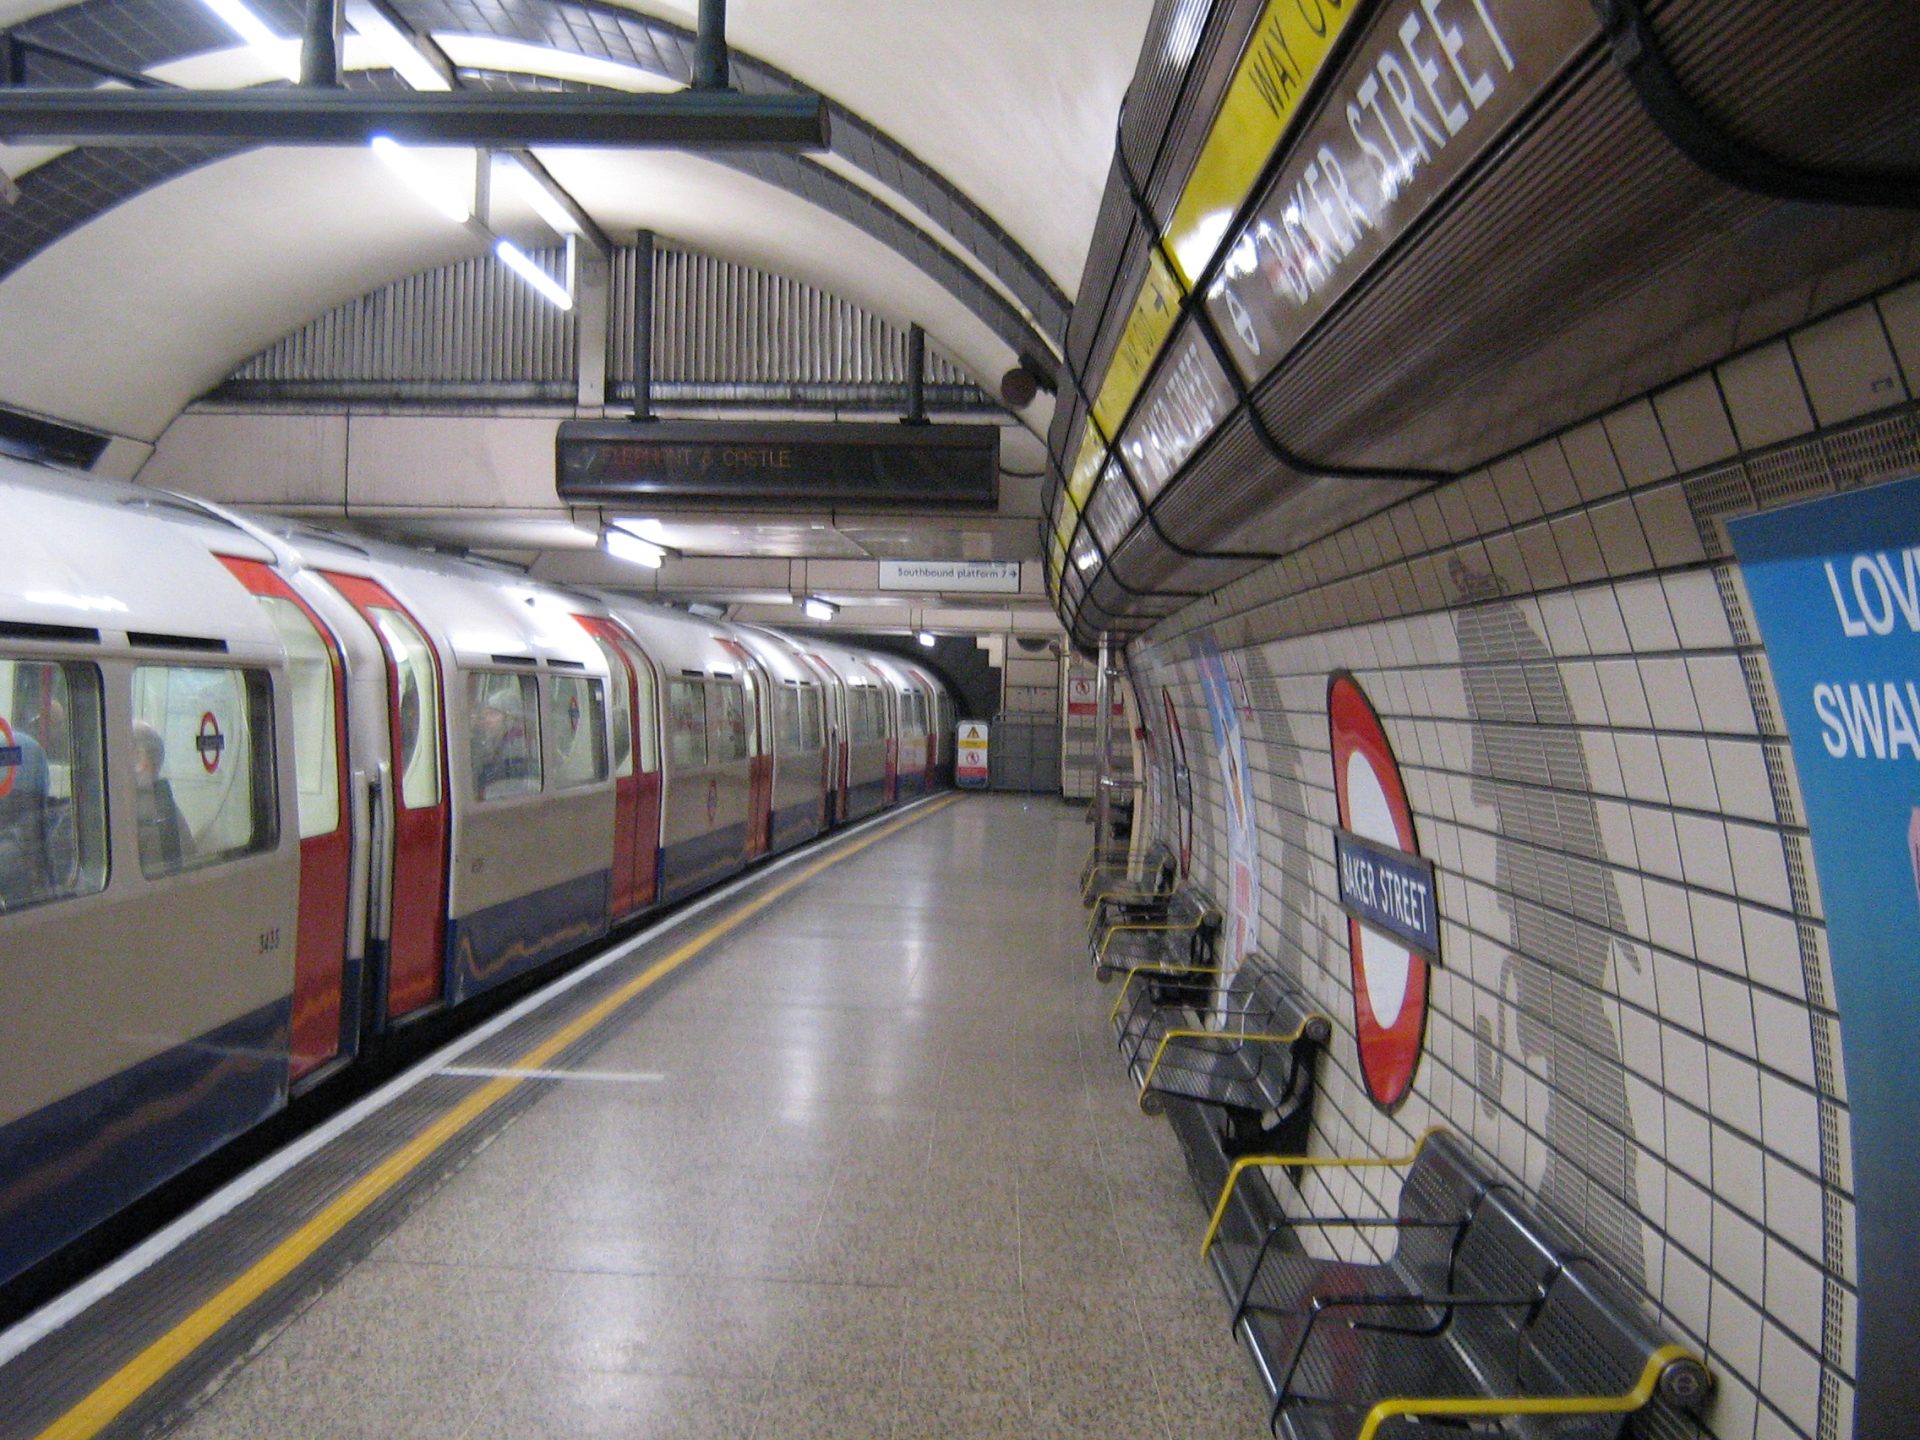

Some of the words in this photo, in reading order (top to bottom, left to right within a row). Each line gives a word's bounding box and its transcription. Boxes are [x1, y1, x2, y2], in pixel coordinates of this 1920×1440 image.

[1248, 15, 1303, 121] WAY
[897, 566, 955, 578] Southbound
[957, 568, 999, 580] platform
[1823, 547, 1920, 638] LOV
[1342, 851, 1378, 910] BAKER
[1379, 866, 1428, 935] STREET
